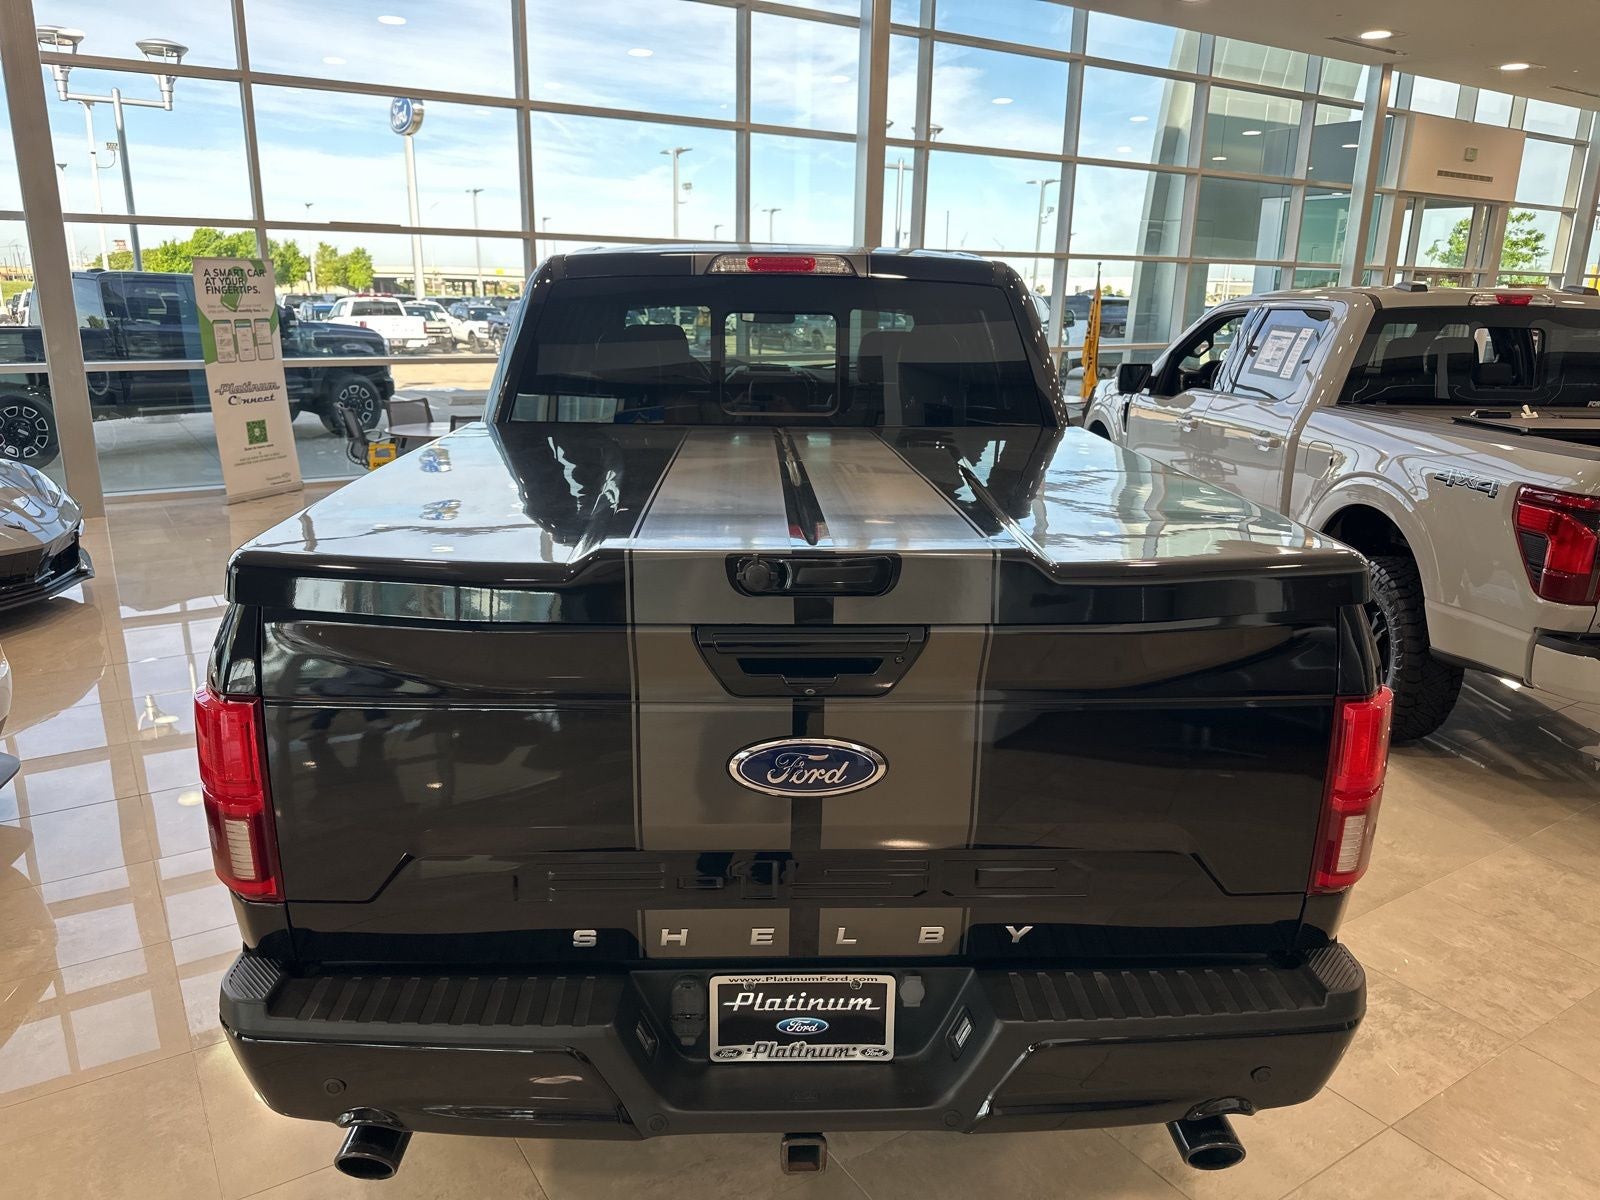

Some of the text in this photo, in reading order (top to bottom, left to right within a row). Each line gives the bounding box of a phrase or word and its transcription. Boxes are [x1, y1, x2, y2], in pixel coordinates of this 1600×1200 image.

[203, 268, 266, 278] A SMART CAR
[204, 277, 245, 286] AT YOUR
[205, 285, 261, 295] FINGERTIPS.
[214, 381, 281, 396] Platinum
[766, 752, 850, 784] Ford
[723, 991, 881, 1012] Platinum
[786, 1018, 818, 1033] Ford
[751, 1041, 858, 1060] Platinum
